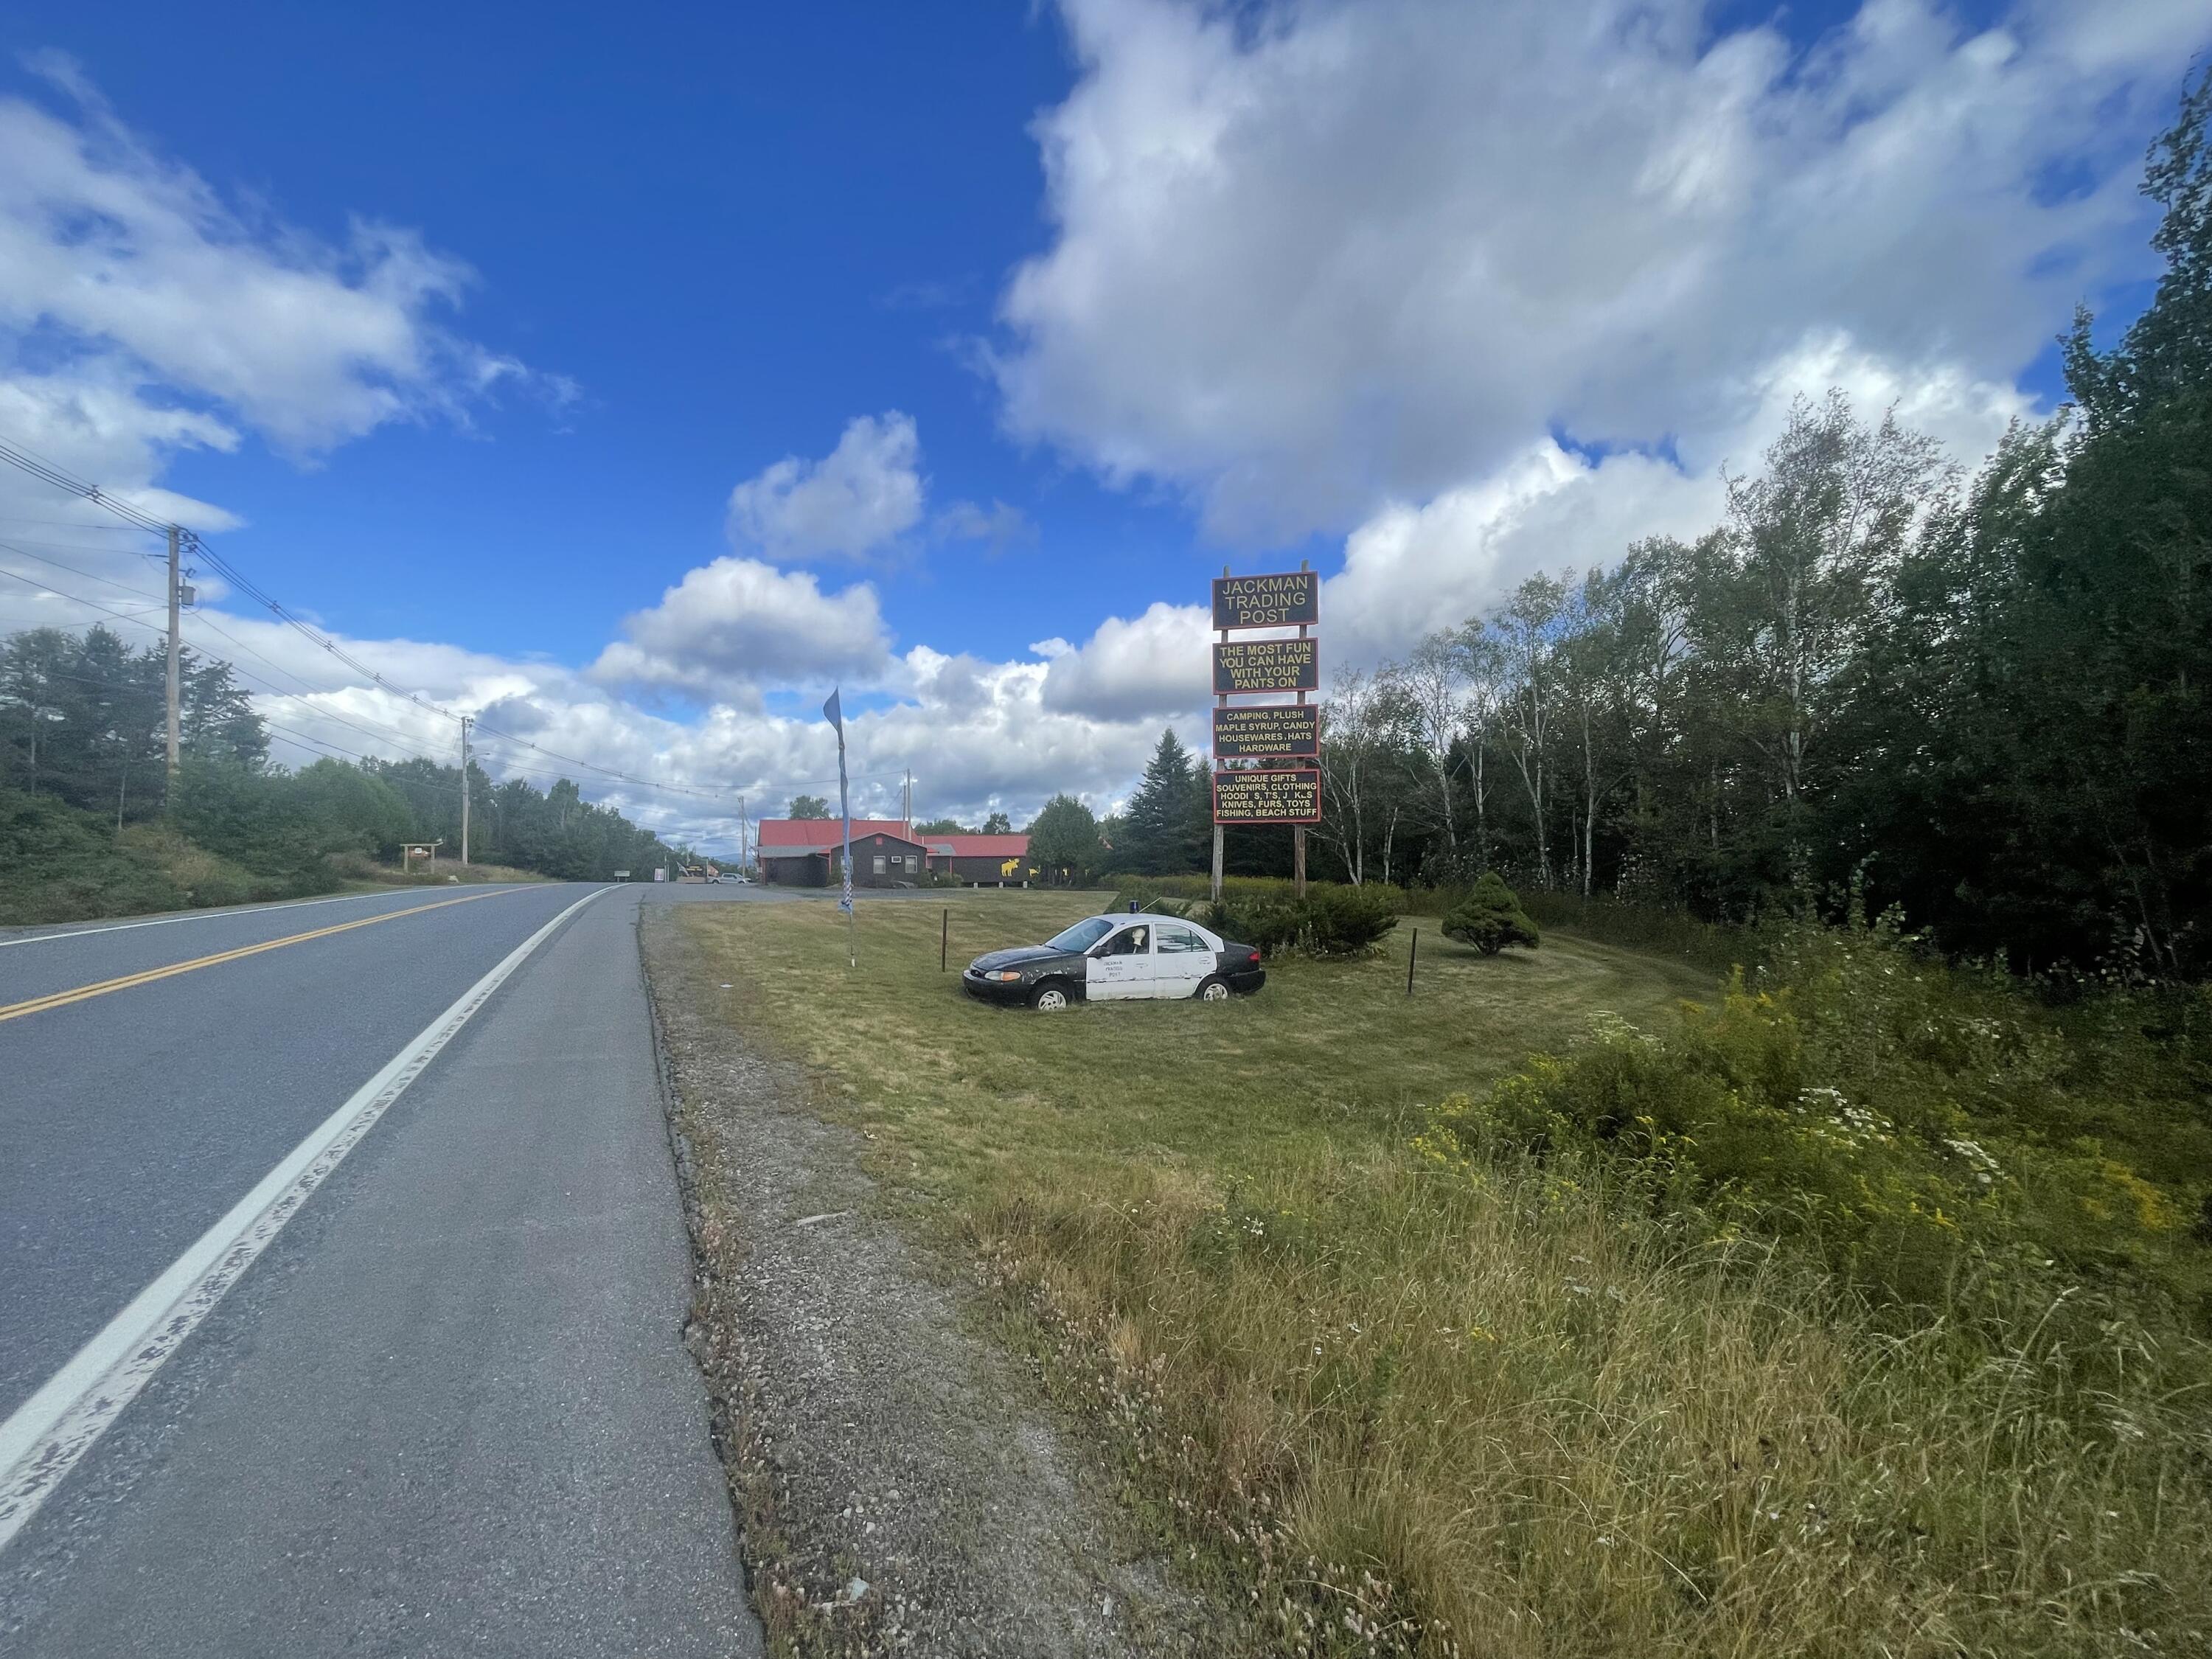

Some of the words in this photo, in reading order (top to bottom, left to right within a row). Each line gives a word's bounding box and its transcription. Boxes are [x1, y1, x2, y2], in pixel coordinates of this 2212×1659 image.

[1222, 576, 1308, 595] JACKMAN
[1225, 592, 1306, 610] TRADING
[1239, 608, 1290, 625] POST
[1220, 646, 1244, 656] THE
[1248, 644, 1282, 655] MOST
[1286, 643, 1311, 653] FUN
[1220, 658, 1244, 668] YOU
[1248, 656, 1274, 666] CAN
[1278, 654, 1311, 664] HAVE
[1231, 668, 1262, 678] WITH
[1265, 666, 1300, 677] YOUR
[1234, 678, 1275, 689] PANTS
[1279, 677, 1296, 687] ON
[1227, 712, 1271, 721] CAMPING,
[1215, 723, 1246, 731] MAPLE
[1249, 723, 1281, 731] SYRUP,
[1283, 721, 1315, 730] CANDY
[1239, 743, 1292, 752] HARDWARE
[1235, 775, 1268, 783] UNIQUE
[1217, 783, 1269, 792] SOUVENIRS,
[1271, 782, 1317, 790] CLOTHING
[1222, 801, 1256, 809] KNIVES,
[1259, 800, 1284, 808] FURS,
